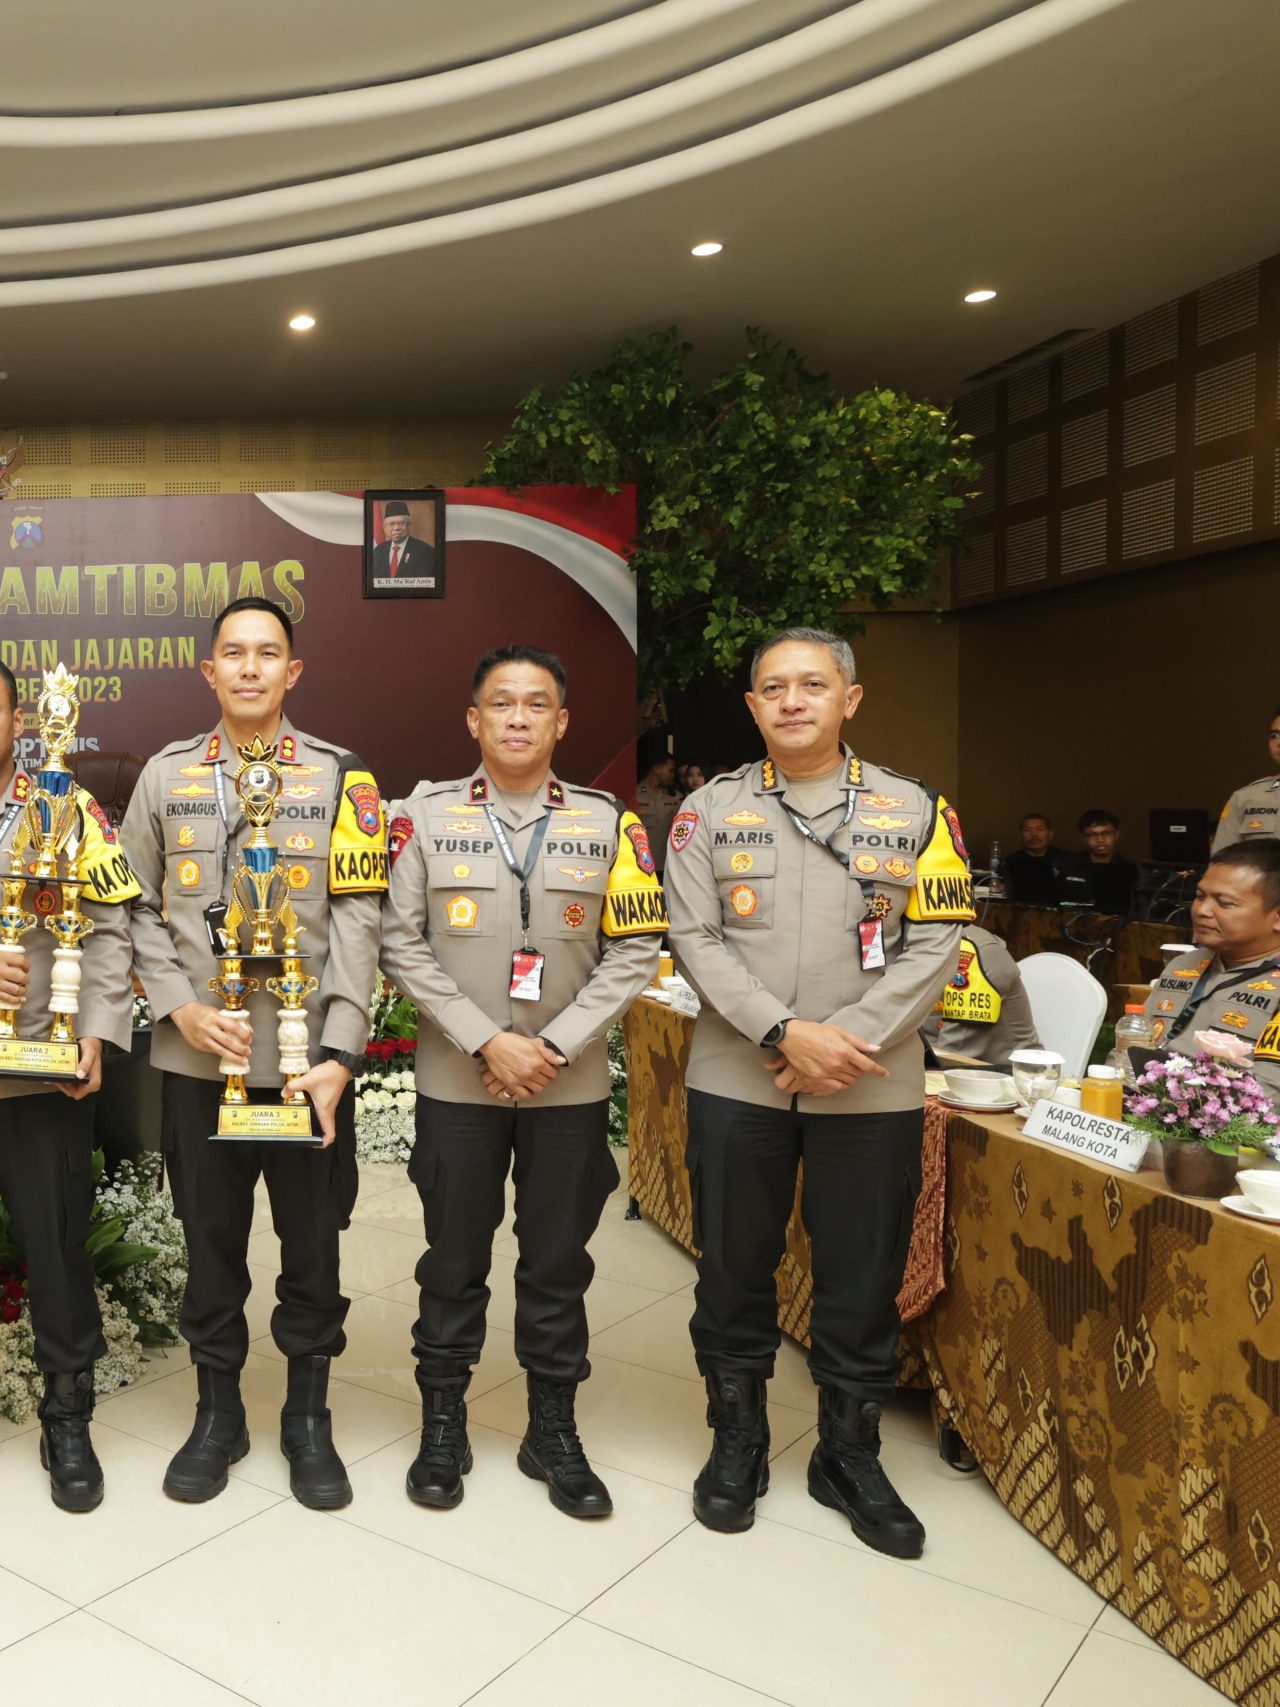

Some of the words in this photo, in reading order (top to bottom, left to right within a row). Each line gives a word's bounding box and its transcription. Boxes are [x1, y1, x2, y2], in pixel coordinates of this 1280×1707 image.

[1, 639, 58, 671] DAN
[70, 636, 196, 672] JAJARAN
[78, 676, 122, 704] 023
[166, 802, 217, 817] EKOBAGUS
[274, 805, 326, 820] POLRI
[433, 838, 494, 854] YUSEP
[714, 830, 774, 846] M.ARIS
[851, 833, 916, 852] POLRI
[547, 841, 608, 858] POLRI
[87, 862, 118, 899] KA
[946, 990, 965, 1007] OPS
[969, 992, 991, 1009] RES
[1227, 991, 1271, 1010] POLRI
[969, 1010, 992, 1020] BRATA
[1257, 1025, 1280, 1052] KA
[20, 1046, 43, 1054] JUARA
[44, 1047, 49, 1055] 2
[1045, 1106, 1132, 1145] KAPOLRESTA
[1041, 1124, 1087, 1148] MALANG
[1085, 1139, 1118, 1160] KOTA
